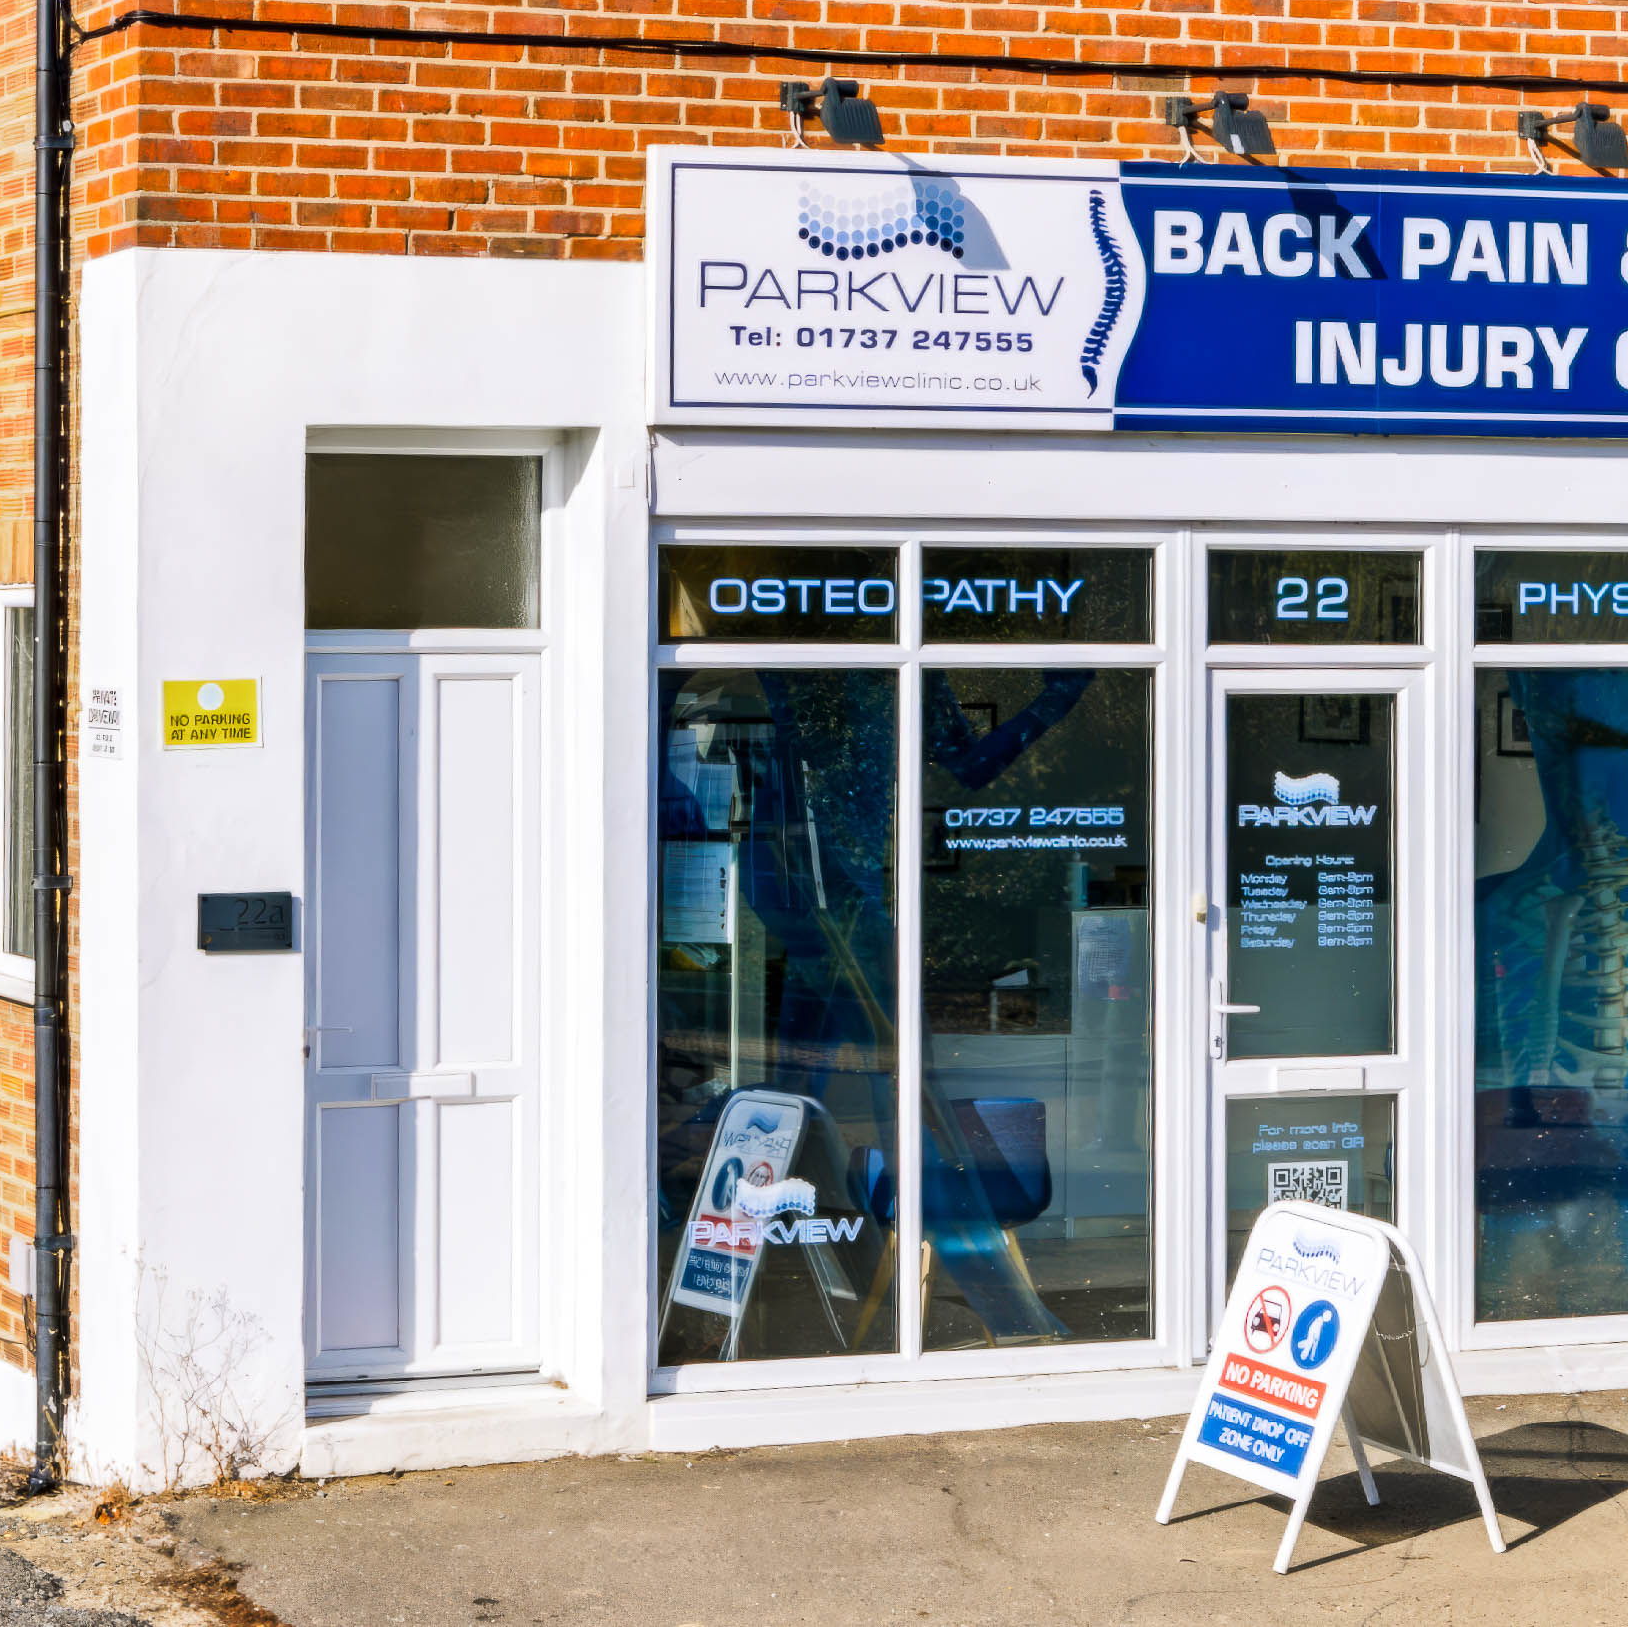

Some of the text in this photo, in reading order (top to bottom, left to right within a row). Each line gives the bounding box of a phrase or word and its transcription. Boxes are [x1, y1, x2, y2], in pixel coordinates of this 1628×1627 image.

[1153, 209, 1373, 279] BACK
[1402, 217, 1588, 286] PAIN
[699, 260, 1065, 317] PARKVIEW
[730, 325, 1034, 353] Tel: 01737 247555
[1295, 320, 1589, 391] INJURY
[714, 369, 1042, 393] www.parkviewclinic.co.uk
[1275, 576, 1349, 620] 22
[170, 713, 251, 727] NO PARKING
[171, 727, 252, 741] AT ANY TIME
[945, 807, 1125, 827] 01737 247555
[1238, 804, 1378, 827] PARKVIEW
[1240, 873, 1288, 885] Monday
[687, 1216, 864, 1246] PARKVIEW
[1256, 1247, 1366, 1297] PARKVIEW
[1225, 1361, 1319, 1409] NO PARKING
[1218, 1427, 1286, 1463] ZONE ONLY
[1252, 1416, 1286, 1440] DROP
[1284, 1427, 1311, 1448] OFF
